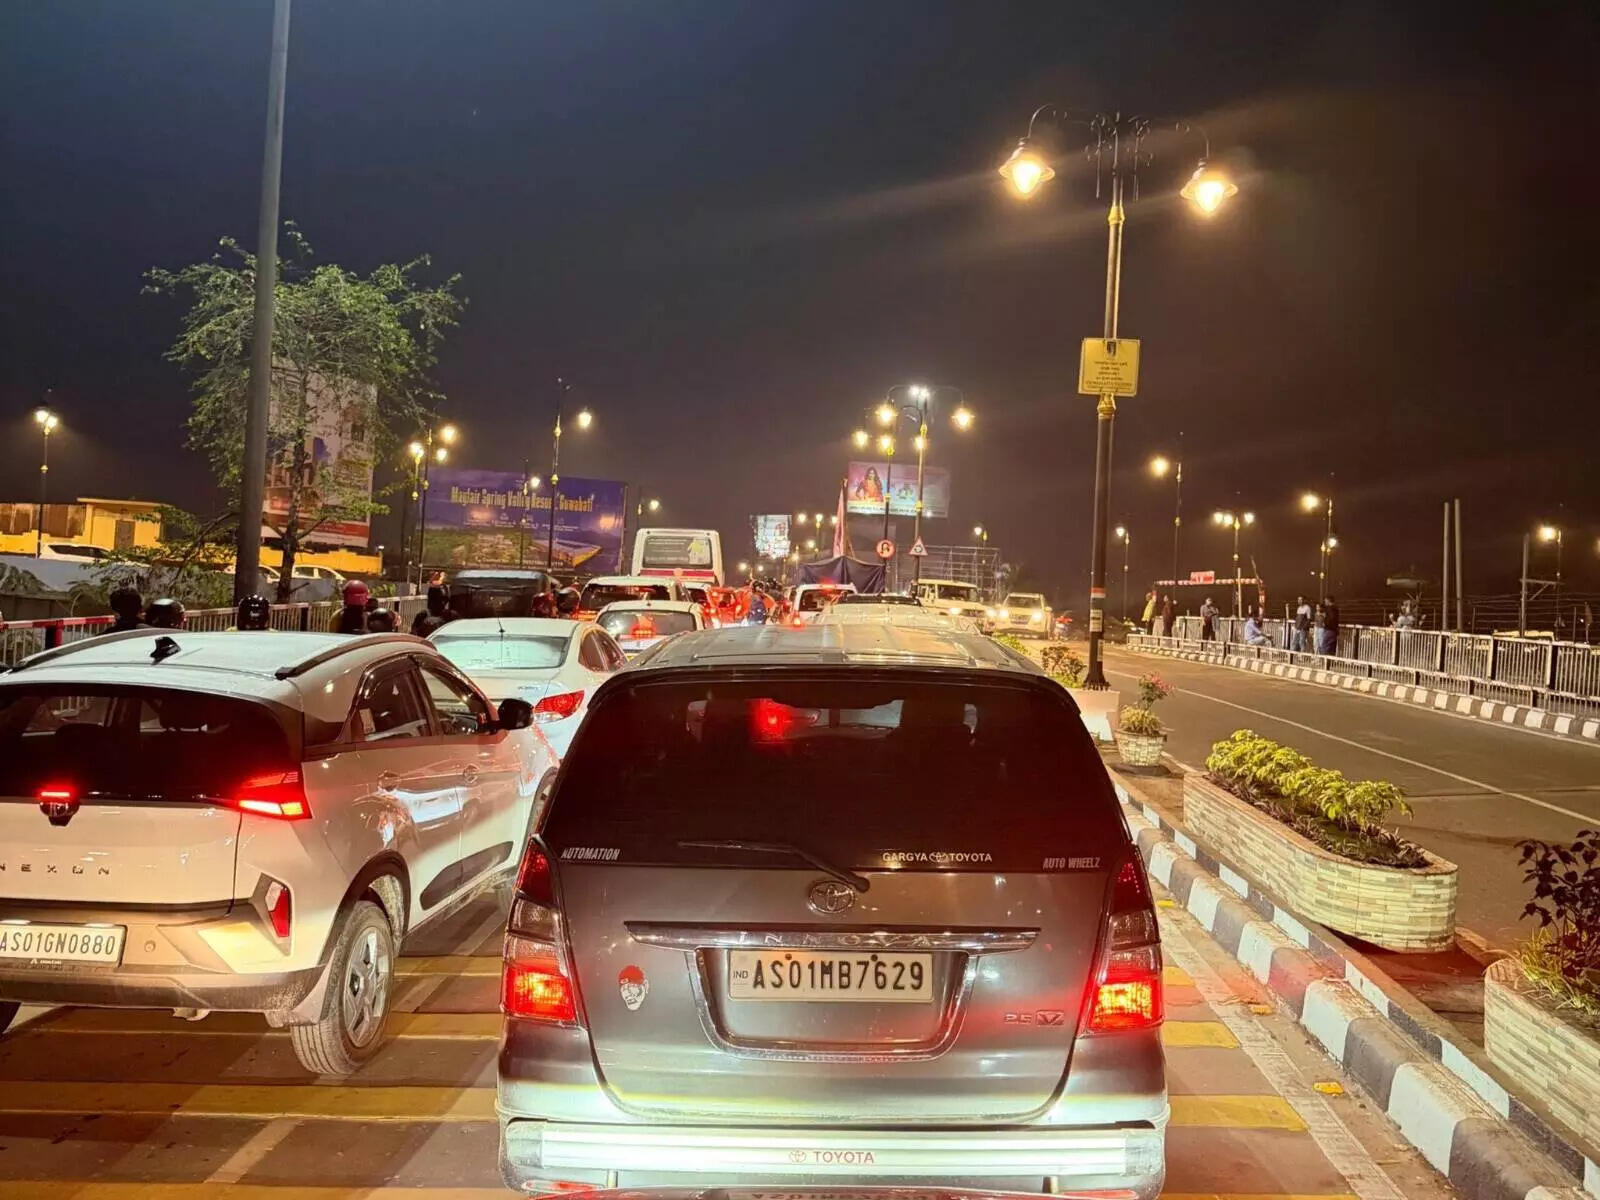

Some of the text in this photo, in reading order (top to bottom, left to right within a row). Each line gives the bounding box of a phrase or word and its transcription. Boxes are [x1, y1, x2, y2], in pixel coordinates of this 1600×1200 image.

[481, 488, 506, 509] Spring
[561, 848, 621, 860] AUTOMATION
[882, 852, 993, 862] GARGYA TOYOTA
[1042, 857, 1101, 869] AUTO WHEELZ
[0, 931, 116, 955] AS01GN0880
[732, 959, 924, 990] IND AS01MB7629
[812, 1151, 875, 1164] TOYOTA
